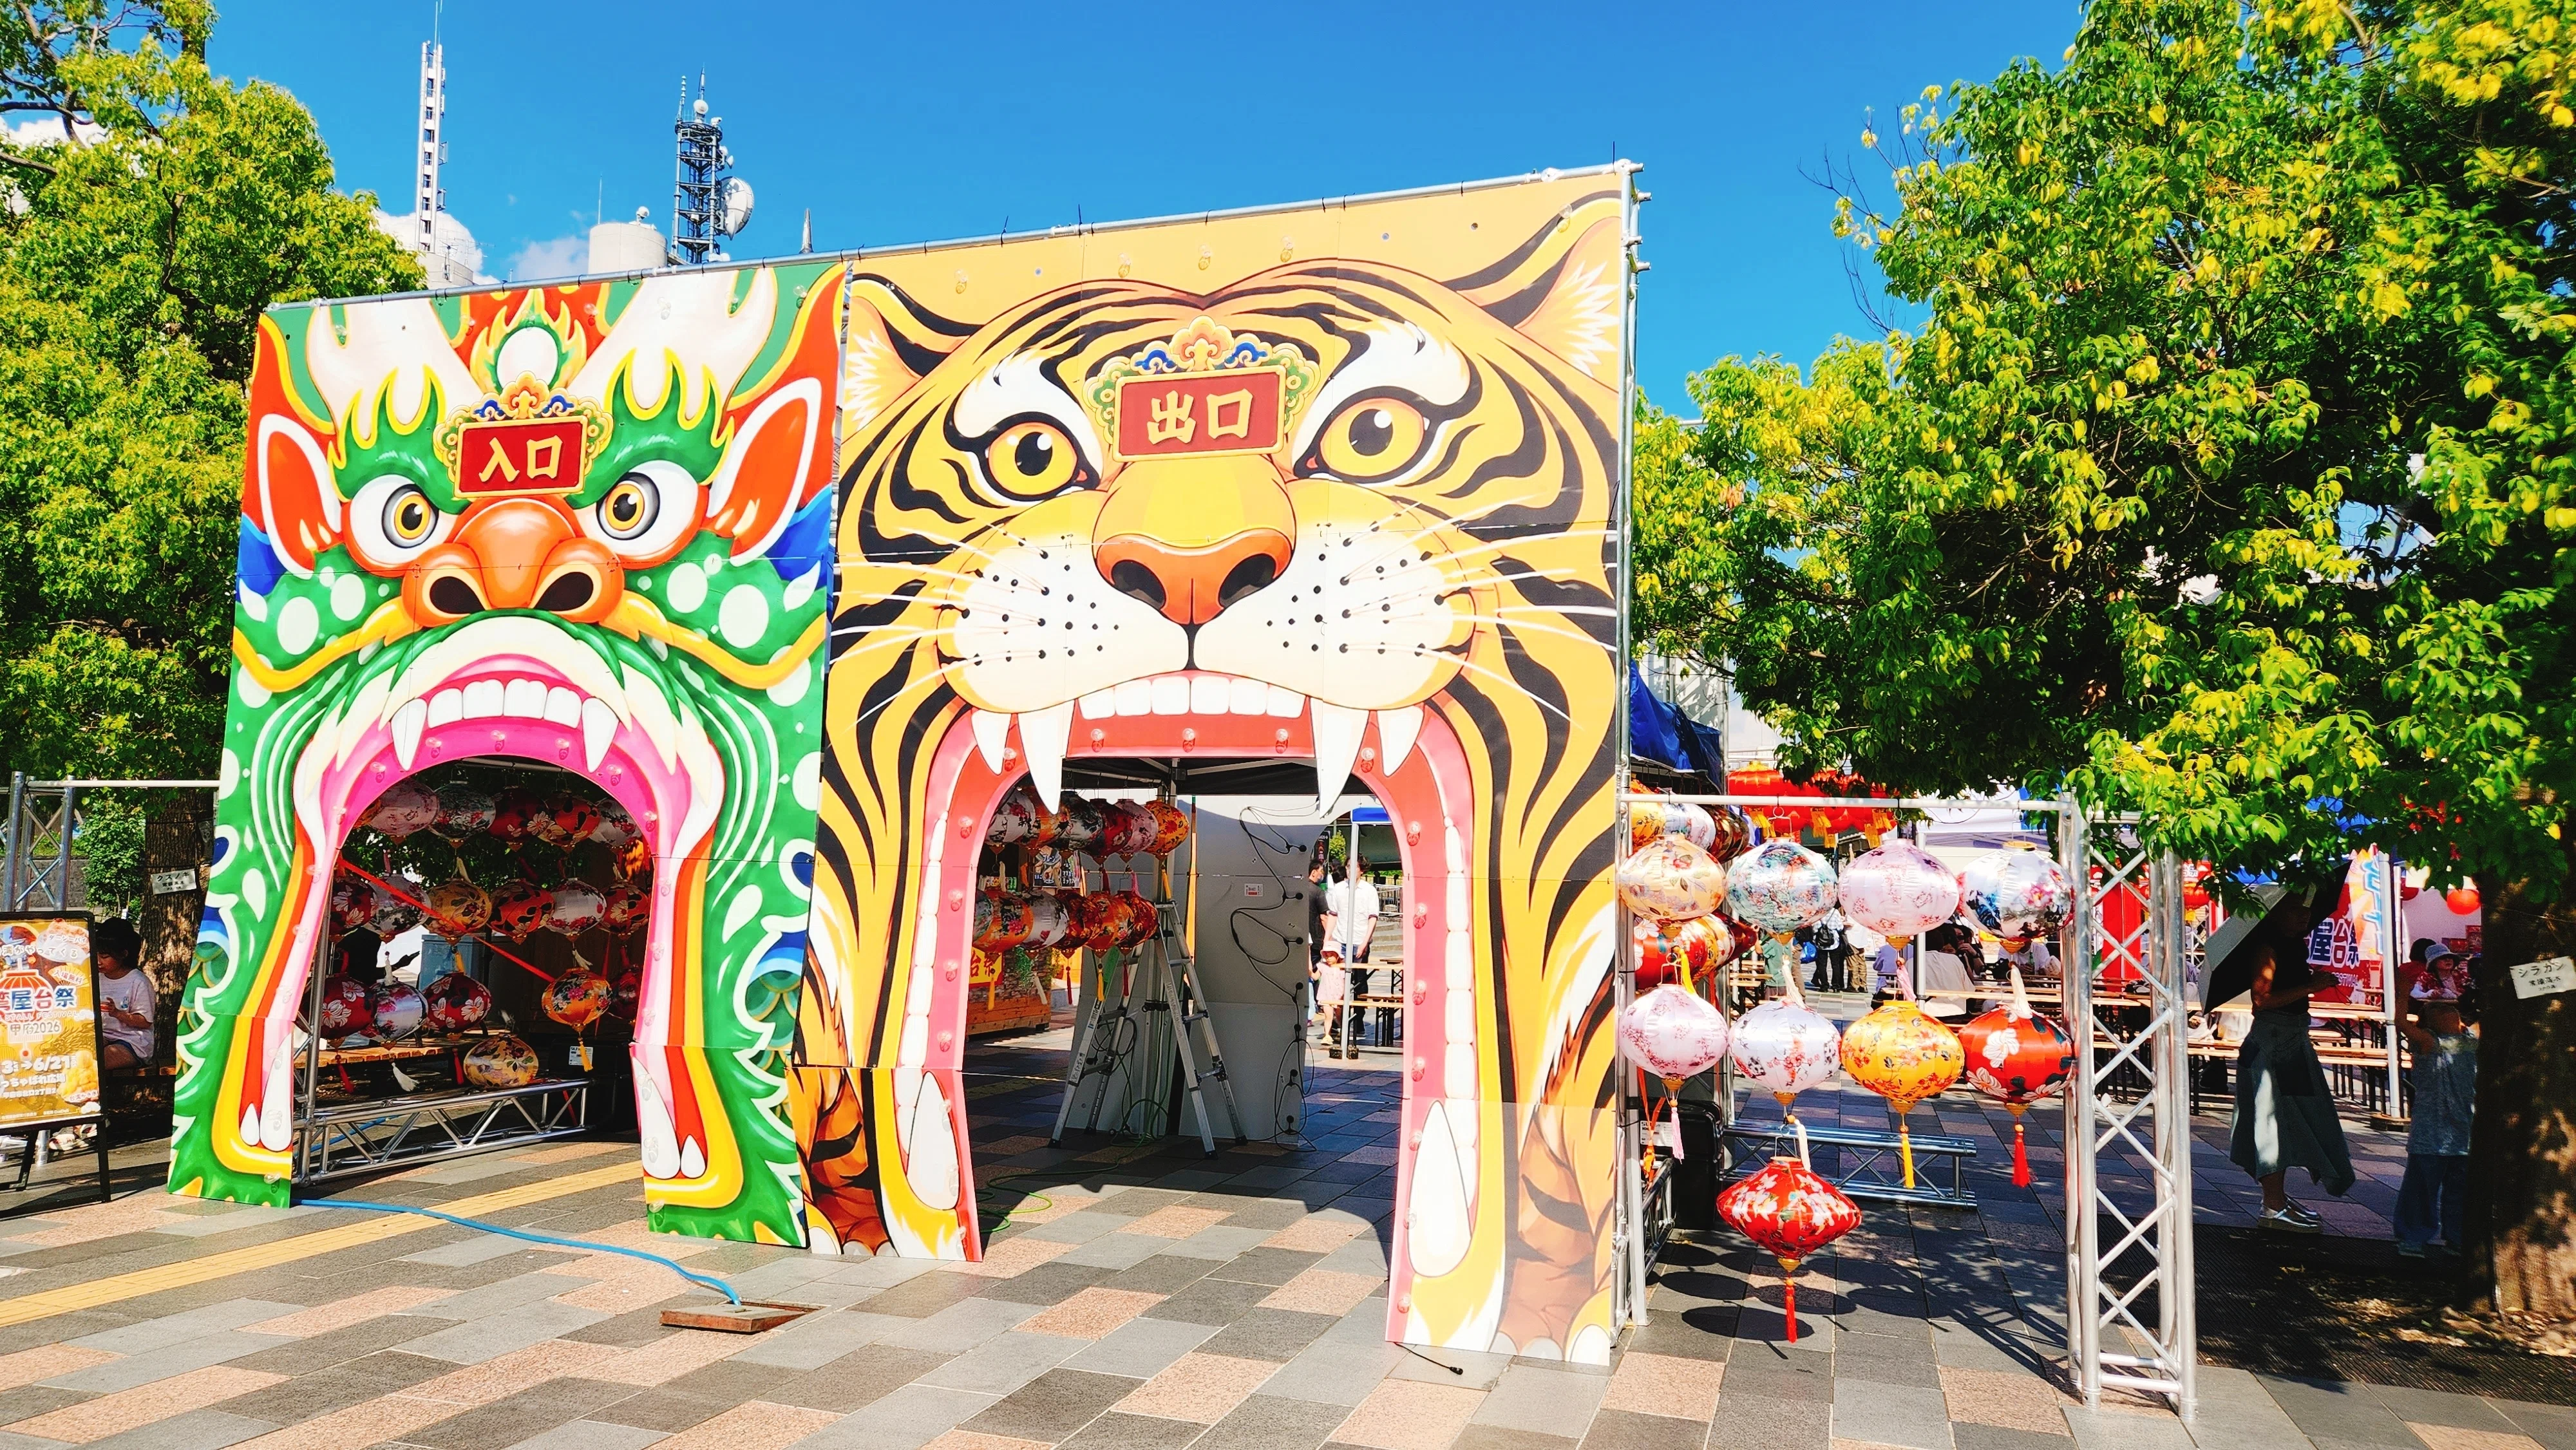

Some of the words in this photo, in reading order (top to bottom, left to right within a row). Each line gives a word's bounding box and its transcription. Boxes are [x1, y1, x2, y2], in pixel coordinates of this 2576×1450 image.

[1147, 388, 1253, 444] 出口
[478, 435, 563, 482] 入口
[157, 872, 189, 882] クスノキ
[1, 945, 79, 958] 湾がやってくる
[2519, 962, 2565, 977] シラカシ
[37, 1010, 78, 1019] FESTIVAL
[33, 1056, 70, 1071] 6/21
